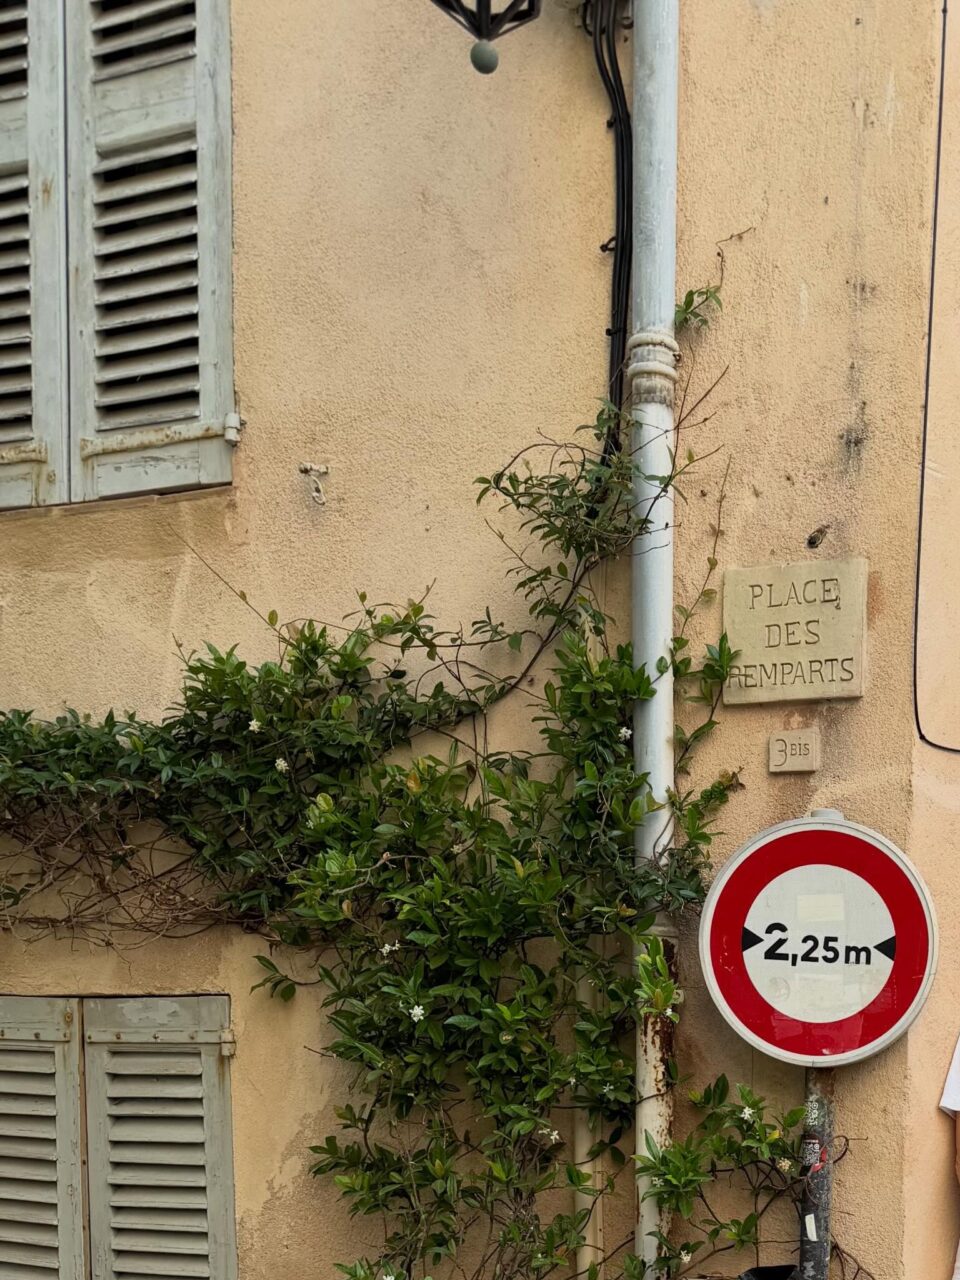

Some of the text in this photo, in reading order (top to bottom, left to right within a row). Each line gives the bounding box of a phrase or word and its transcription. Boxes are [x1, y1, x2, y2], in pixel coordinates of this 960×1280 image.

[749, 578, 839, 609] PLACE
[765, 619, 820, 648] DES
[727, 657, 854, 688] REMPARTS
